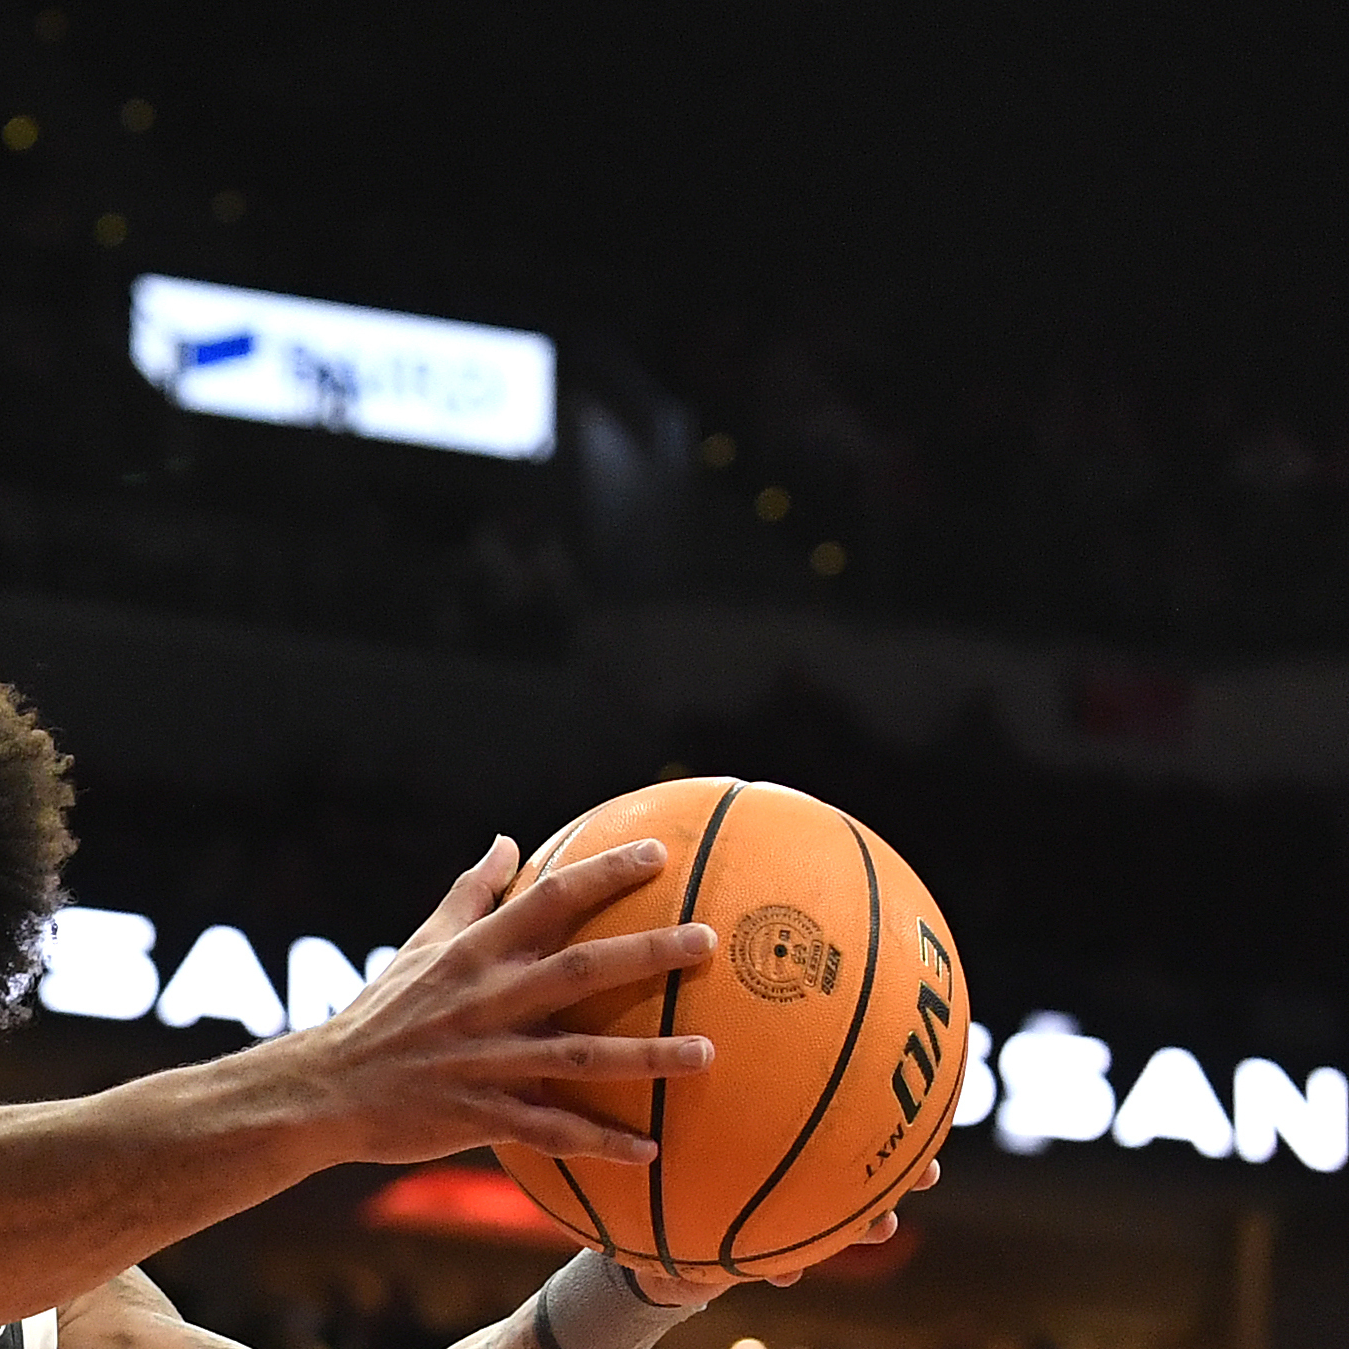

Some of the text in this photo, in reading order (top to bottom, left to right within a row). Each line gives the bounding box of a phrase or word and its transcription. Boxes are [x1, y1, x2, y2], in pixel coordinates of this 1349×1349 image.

[36, 905, 400, 1040] SAN
[891, 917, 953, 1127] EVO
[952, 1021, 1349, 1174] SAN
